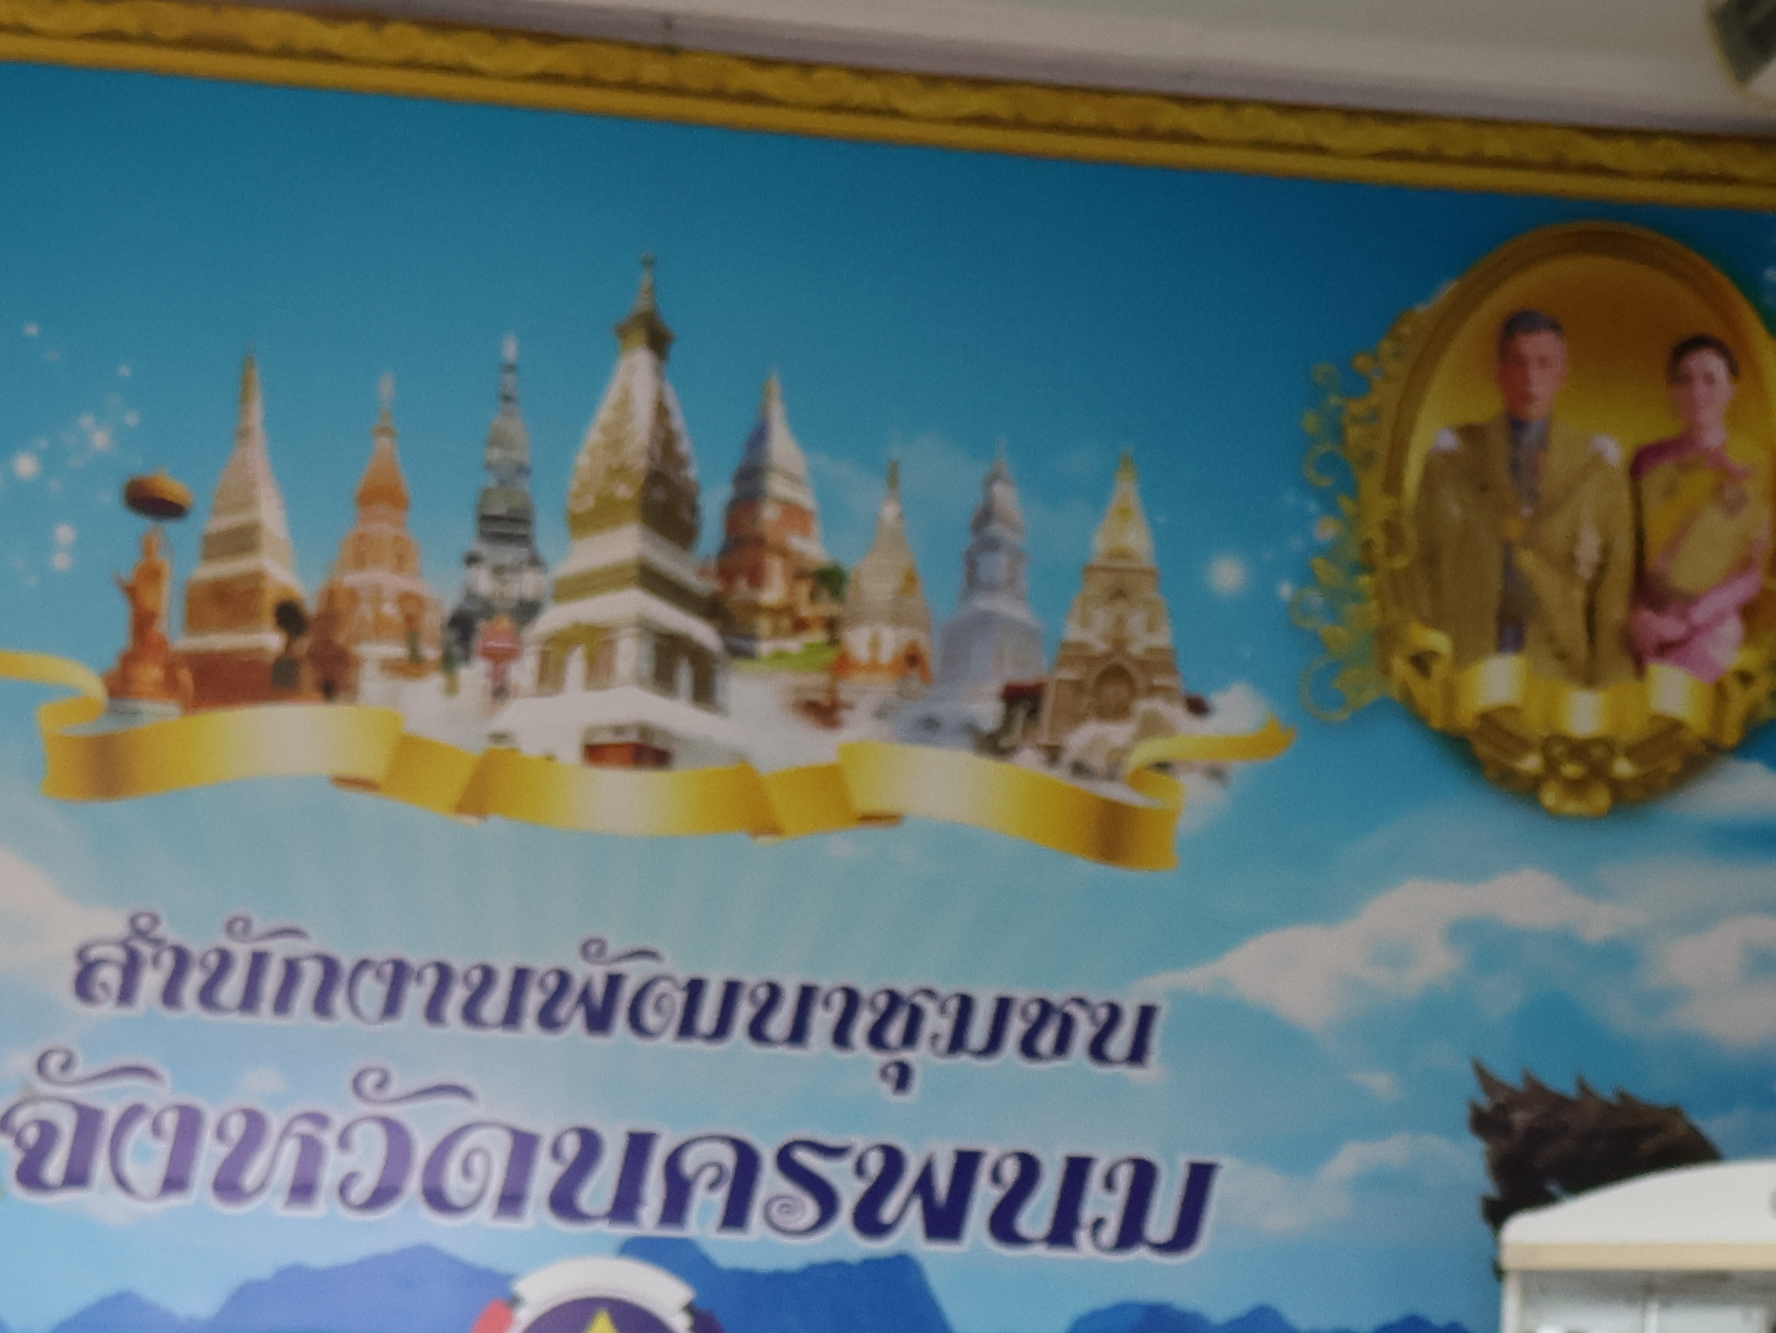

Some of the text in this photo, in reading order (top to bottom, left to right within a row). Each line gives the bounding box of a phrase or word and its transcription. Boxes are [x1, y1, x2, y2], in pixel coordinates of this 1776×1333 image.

[70, 911, 1162, 1094] สำนักงานพัฒนาชุมชน
